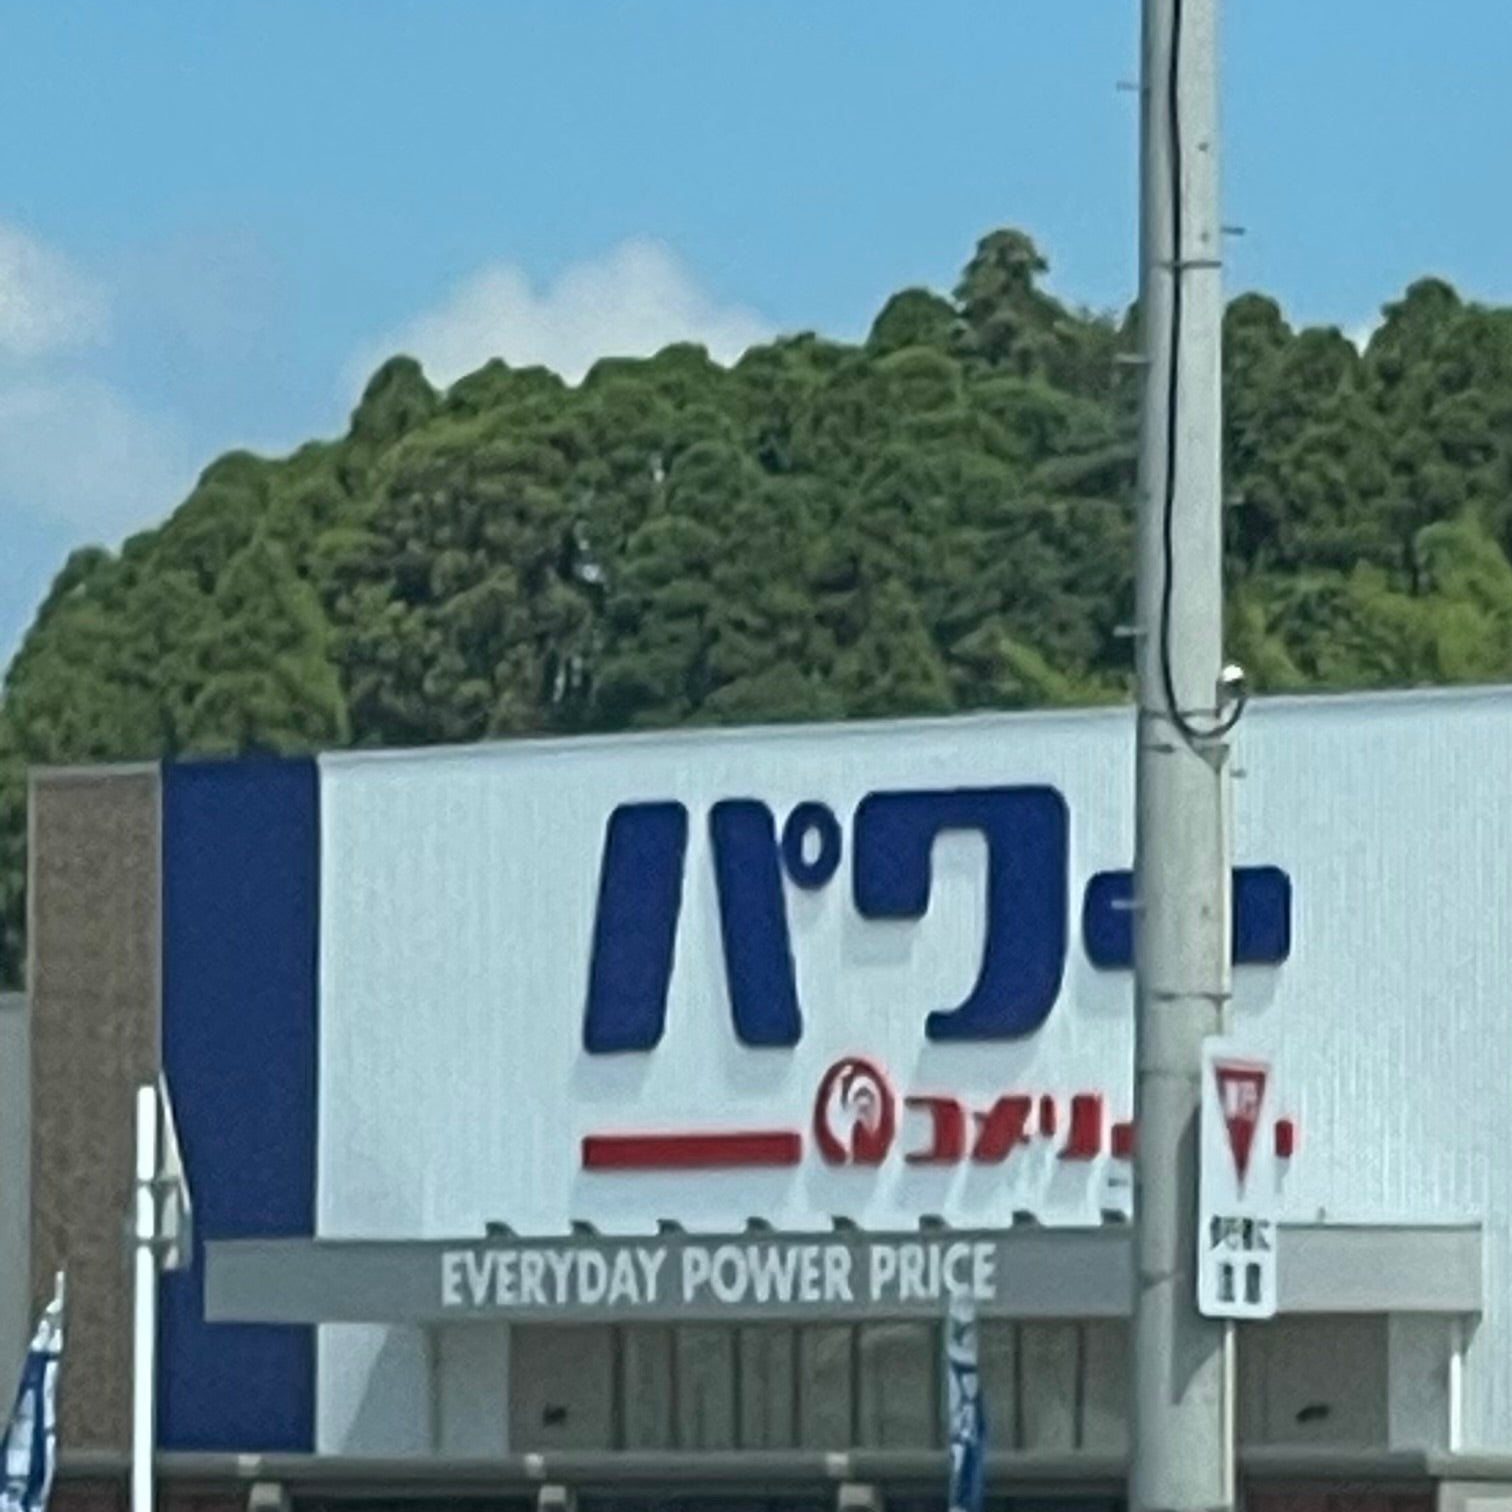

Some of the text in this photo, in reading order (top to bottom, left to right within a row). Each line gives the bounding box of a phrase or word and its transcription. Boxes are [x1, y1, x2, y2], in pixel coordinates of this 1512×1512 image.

[583, 783, 1292, 1055] パワー
[440, 1240, 998, 1307] EVERYDAY POWER PRICE
